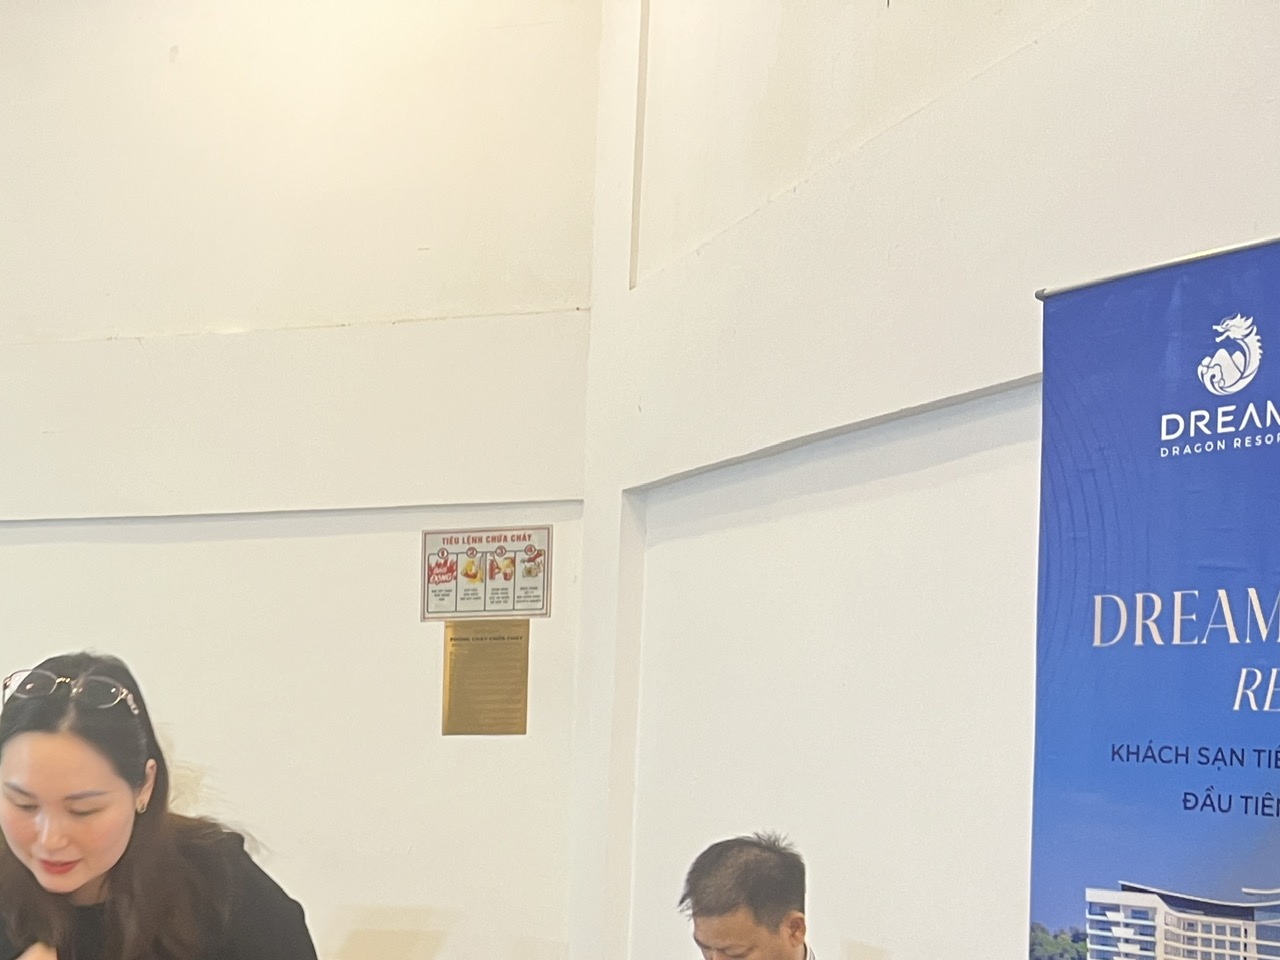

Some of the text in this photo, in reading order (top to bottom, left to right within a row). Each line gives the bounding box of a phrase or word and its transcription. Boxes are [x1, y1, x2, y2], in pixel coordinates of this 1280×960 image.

[1161, 439, 1225, 457] DRAGON
[1092, 587, 1280, 647] DREAM
[1111, 739, 1189, 764] KHÁCH
[1197, 746, 1245, 771] SẠN
[1182, 785, 1280, 818] ĐẦU TIÊ
